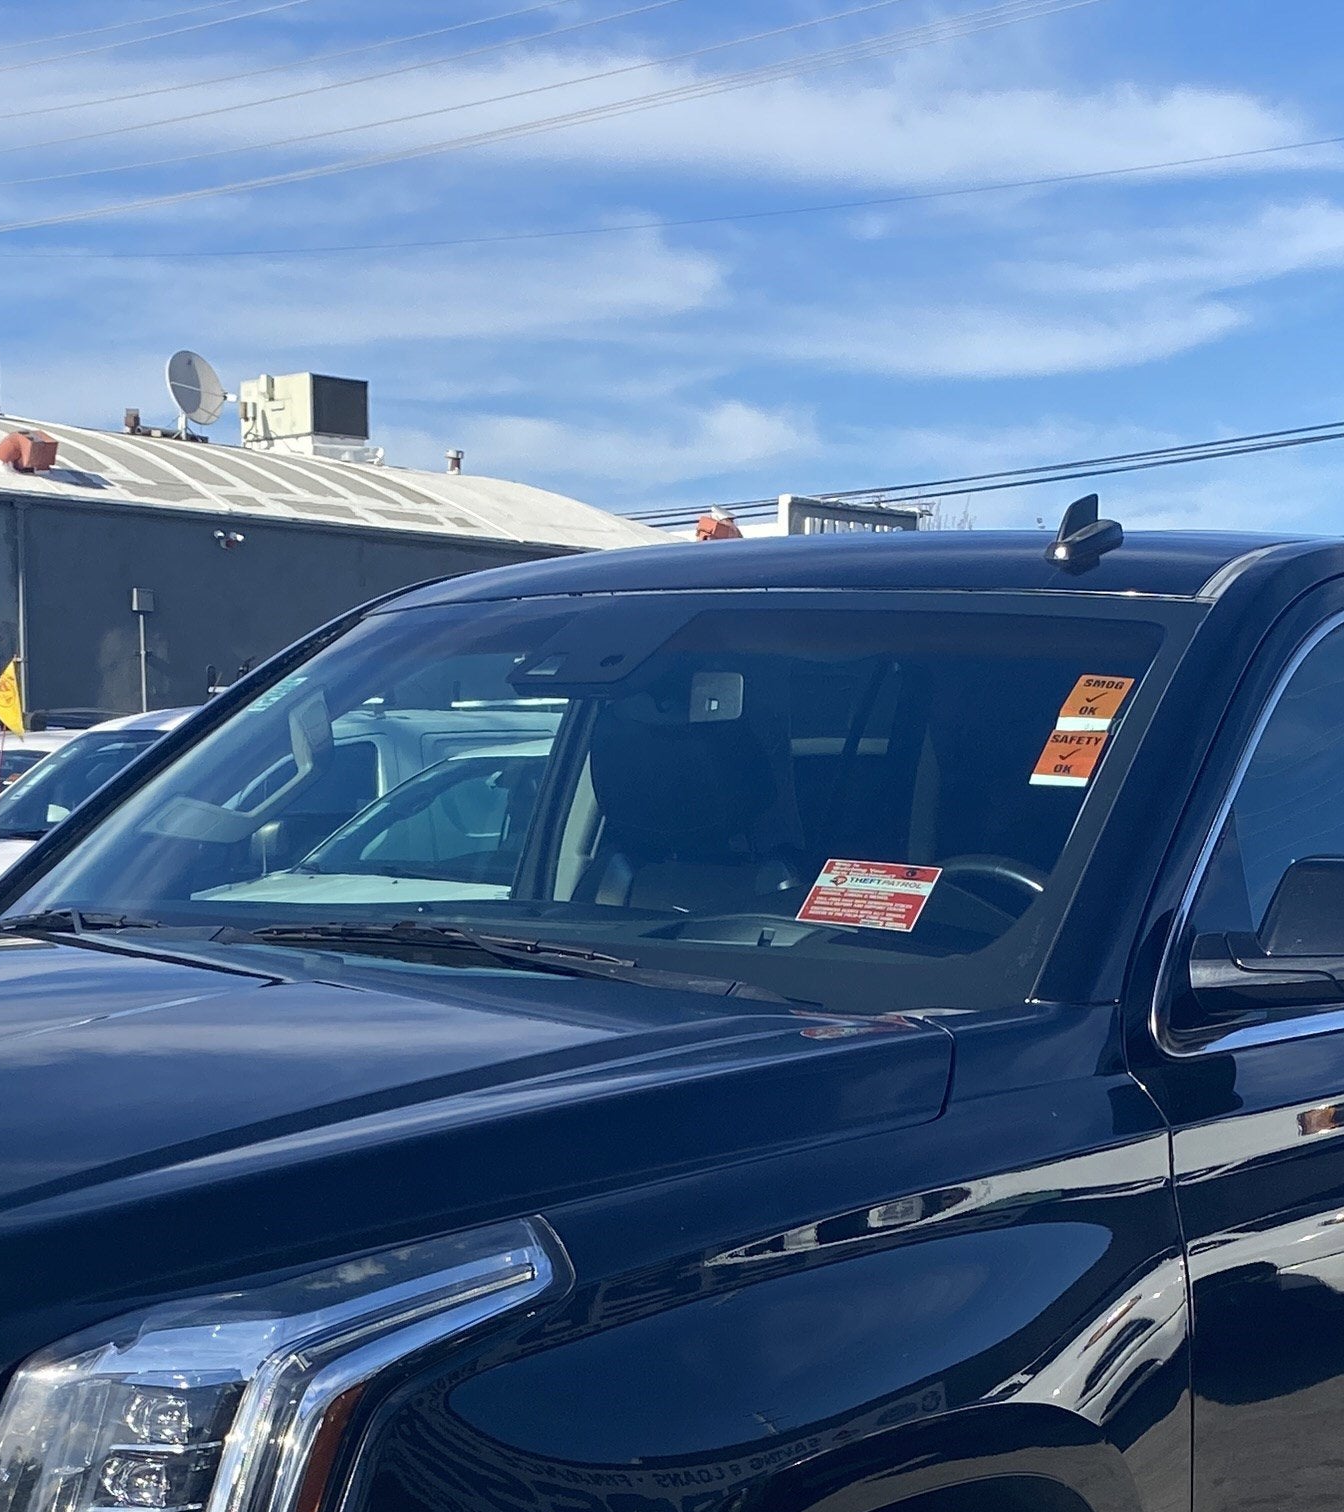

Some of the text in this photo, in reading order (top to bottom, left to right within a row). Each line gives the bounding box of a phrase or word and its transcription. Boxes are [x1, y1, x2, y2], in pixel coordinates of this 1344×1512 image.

[1083, 679, 1125, 690] SMOG
[1078, 706, 1097, 716] OK
[1050, 734, 1102, 746] SAFETY
[1053, 764, 1073, 774] OK
